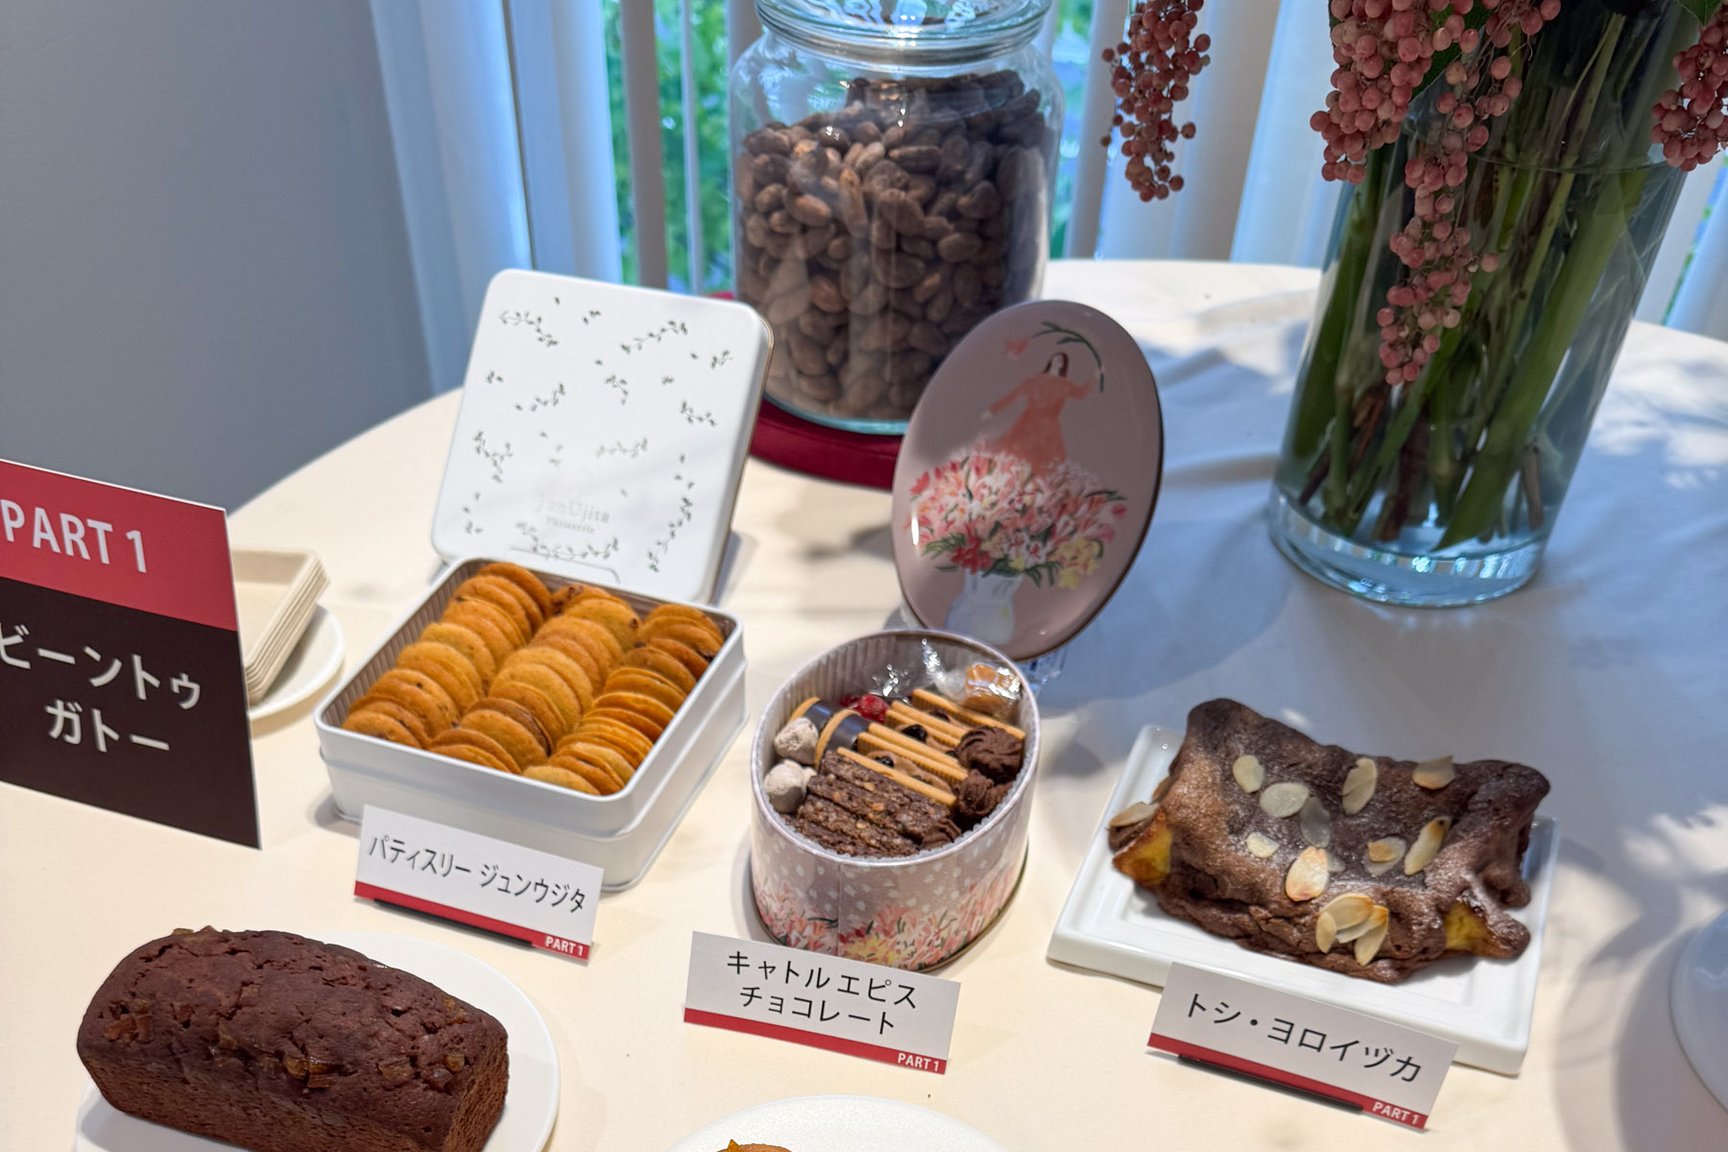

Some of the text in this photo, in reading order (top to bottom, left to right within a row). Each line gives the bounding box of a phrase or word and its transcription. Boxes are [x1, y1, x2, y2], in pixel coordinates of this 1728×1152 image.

[0, 499, 147, 573] PART 1
[0, 622, 200, 710] ビーントゥ
[44, 698, 170, 753] ガトー
[369, 834, 585, 913] パティスリー ジュンウジタ
[545, 935, 584, 956] PART 1
[727, 951, 916, 1009] キャトルエピス
[740, 985, 894, 1035] チョコレート
[1187, 993, 1422, 1083] トシ・ヨロイヅカ
[897, 1053, 939, 1071] PART 1
[1373, 1101, 1419, 1125] PART 1
